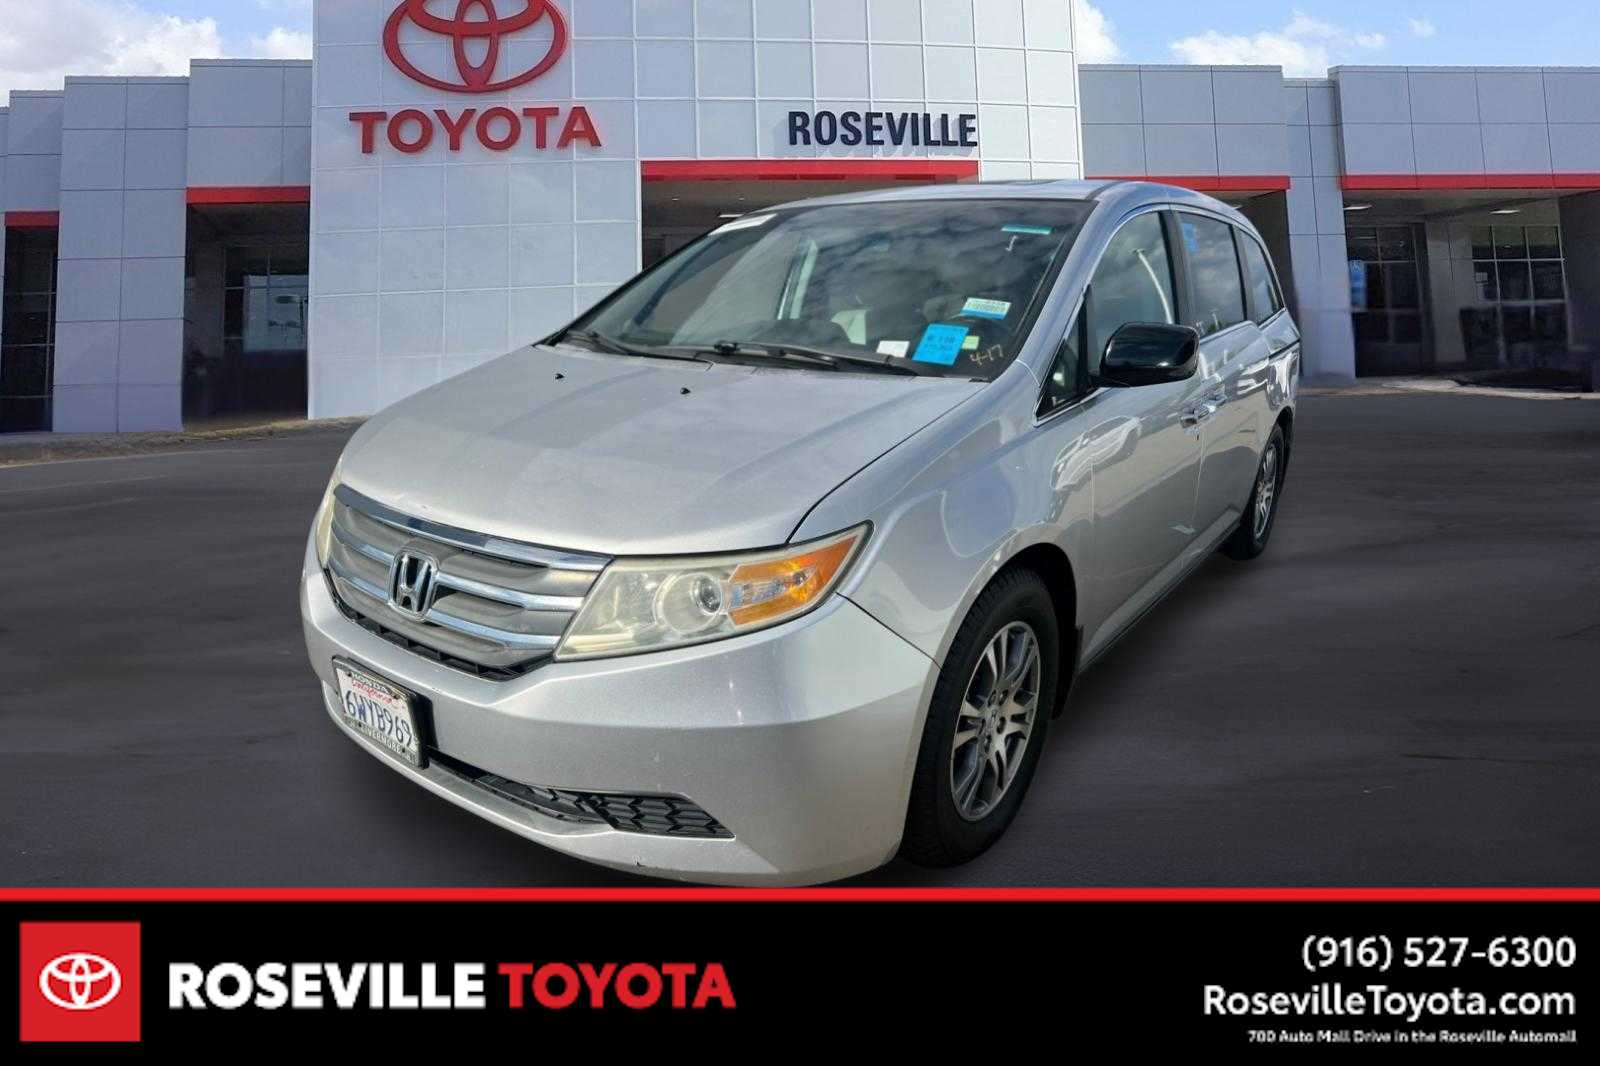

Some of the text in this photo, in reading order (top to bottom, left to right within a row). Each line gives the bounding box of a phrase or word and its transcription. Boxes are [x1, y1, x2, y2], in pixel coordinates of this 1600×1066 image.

[349, 106, 603, 153] TOYOTA
[789, 111, 978, 147] ROSEVILLE
[345, 690, 413, 747] 6WYB969
